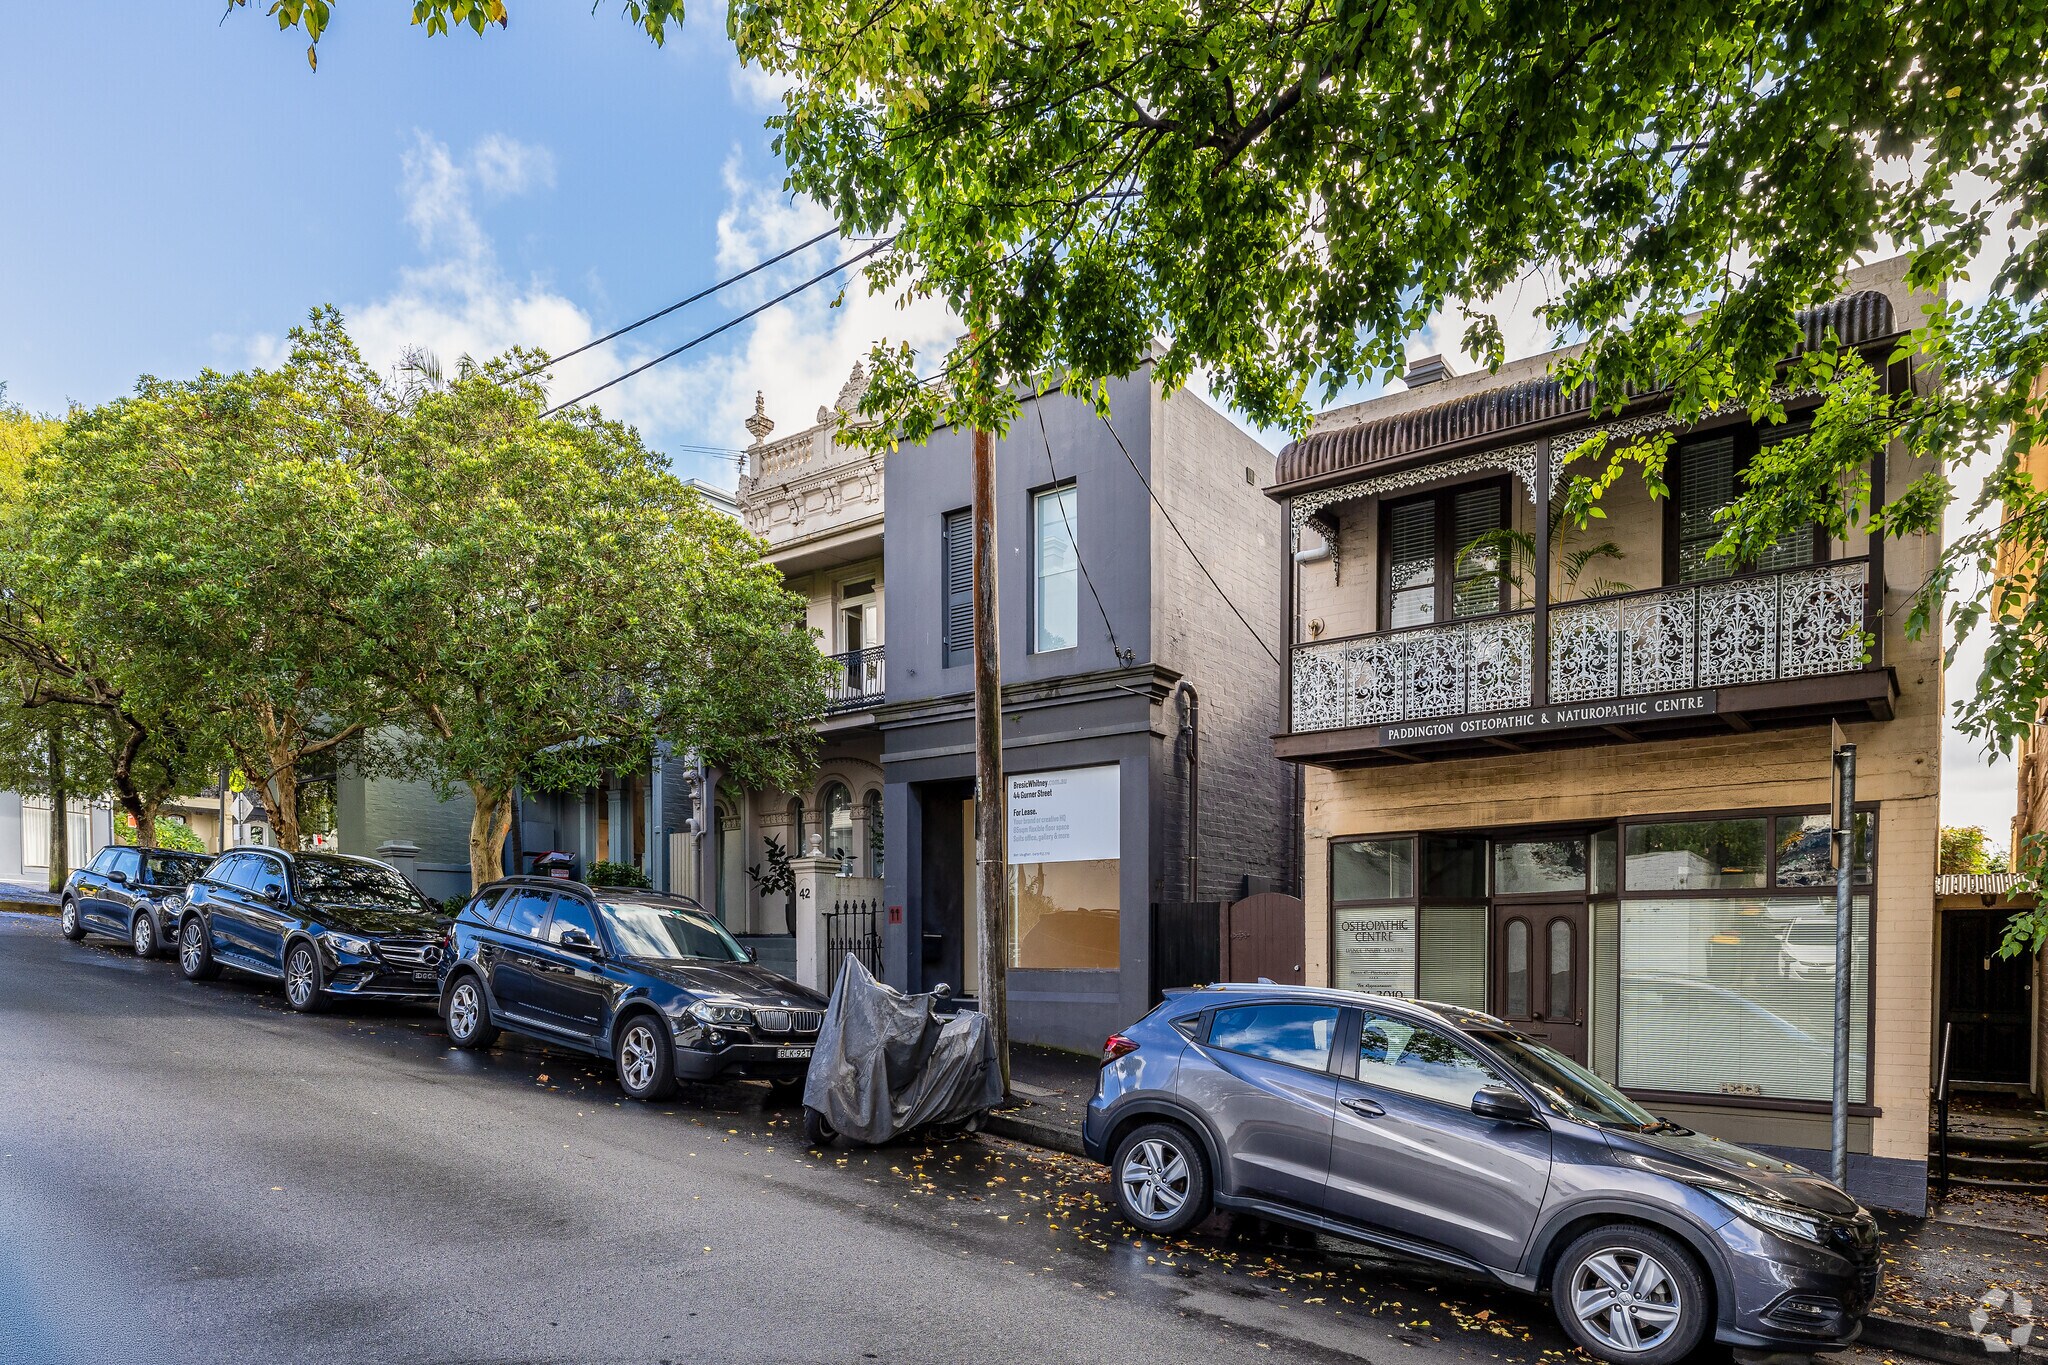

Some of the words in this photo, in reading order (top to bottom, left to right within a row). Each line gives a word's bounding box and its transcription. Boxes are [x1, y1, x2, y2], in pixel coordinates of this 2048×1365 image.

[1388, 723, 1453, 740] PADDINGTON
[1460, 714, 1535, 733] OSTEOPATHIC
[1541, 712, 1550, 724] &
[1556, 702, 1648, 723] NATUROPATHIC
[1654, 696, 1705, 712] CENTRE
[1013, 791, 1020, 799] 44
[1020, 790, 1037, 799] Gurner
[1037, 789, 1053, 798] Street
[1013, 808, 1021, 817] For
[1021, 808, 1038, 816] Lease.
[1056, 824, 1070, 832] space
[1038, 833, 1054, 842] gallery
[799, 887, 811, 899] 42
[1341, 919, 1409, 931] OSTEOPATHIC
[1355, 932, 1394, 942] CENTRE
